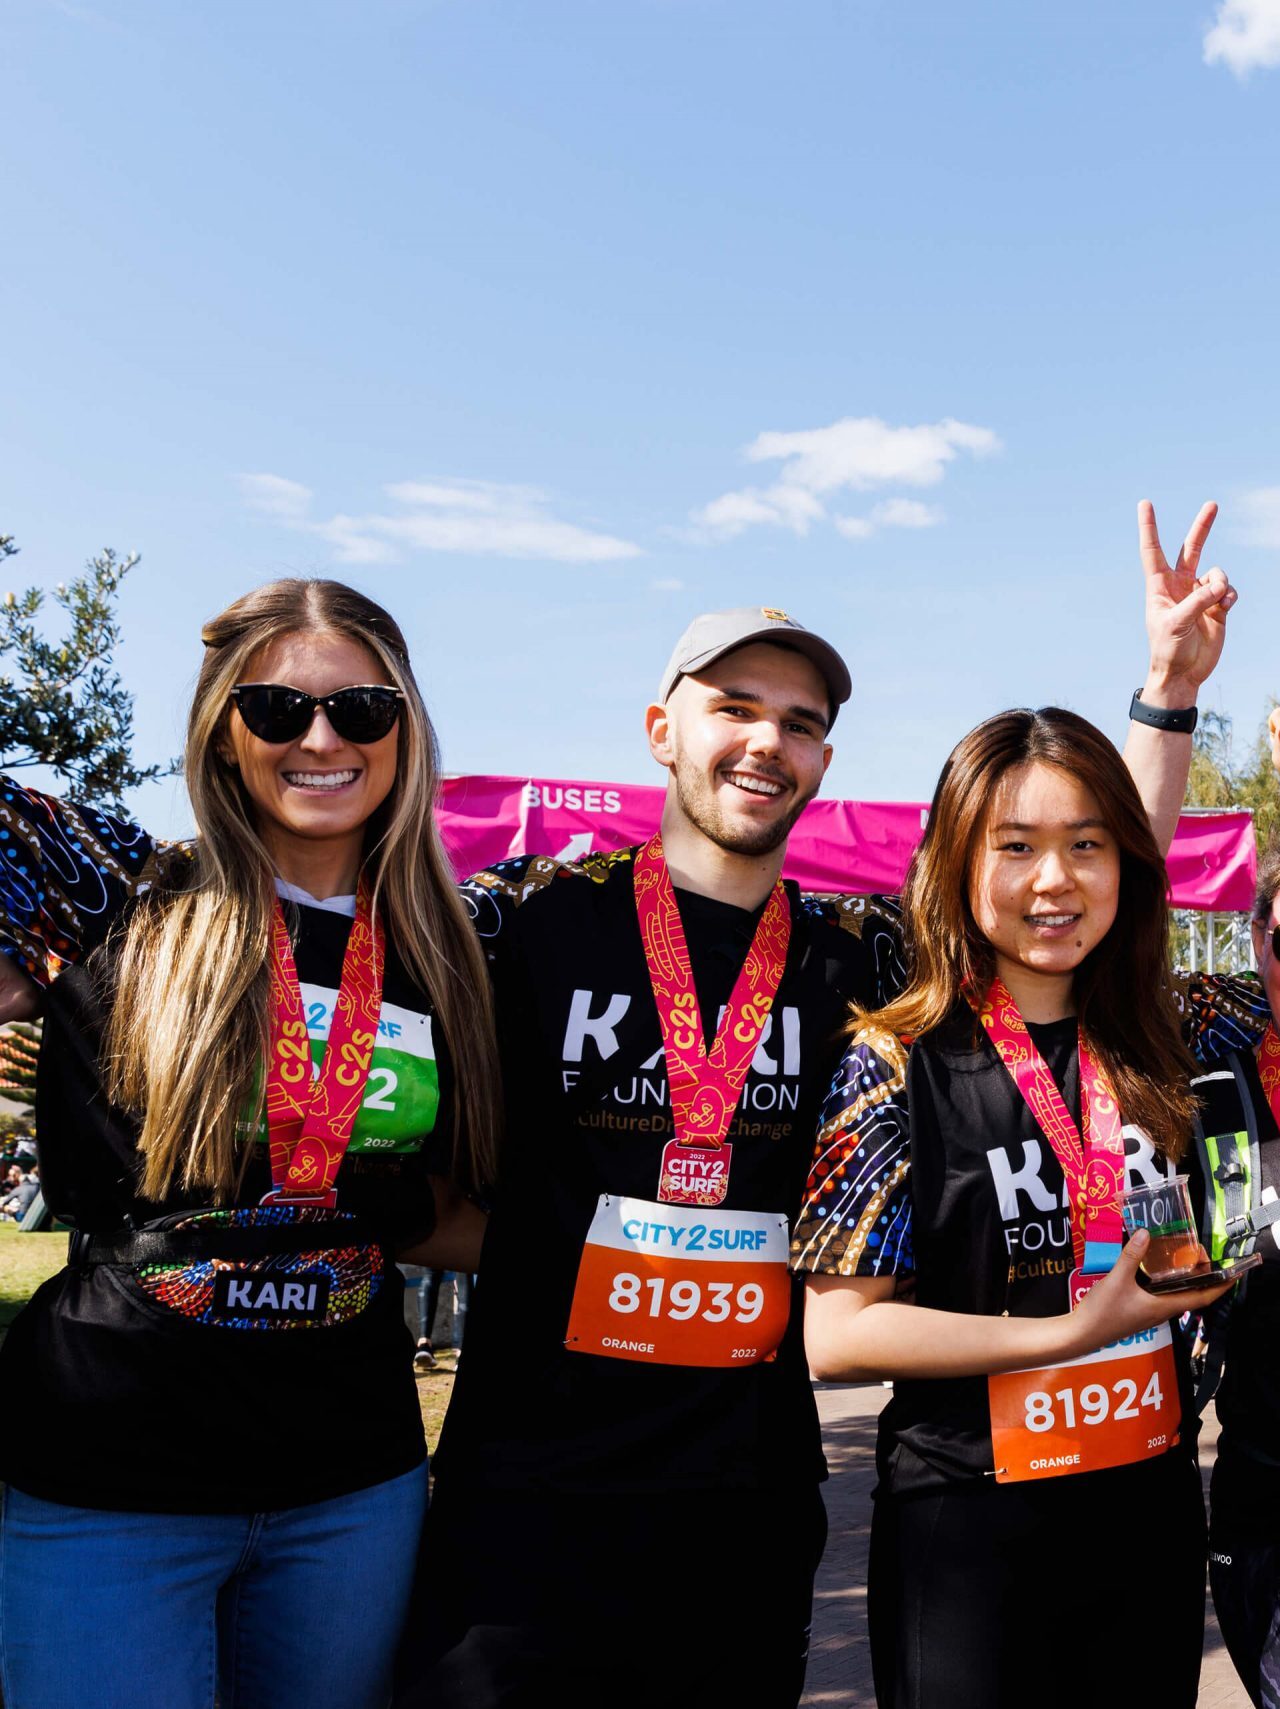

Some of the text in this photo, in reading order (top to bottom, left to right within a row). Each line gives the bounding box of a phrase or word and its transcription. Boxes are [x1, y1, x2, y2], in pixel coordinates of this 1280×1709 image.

[522, 786, 621, 813] BUSES
[670, 992, 697, 1050] C2S
[733, 991, 774, 1043] C2S
[277, 1021, 309, 1083] C2S
[335, 1029, 375, 1087] C2S
[364, 1137, 395, 1148] 2022
[668, 1158, 725, 1179] CITY2
[670, 1175, 721, 1194] SURF
[623, 1219, 767, 1251] CITY2SURF
[227, 1280, 317, 1310] KARI
[609, 1272, 765, 1324] 81939
[602, 1337, 655, 1353] ORANGE
[731, 1348, 757, 1359] 2022
[1024, 1372, 1163, 1433] 81924
[1147, 1434, 1167, 1449] 2022
[1029, 1454, 1081, 1471] ORANGE
